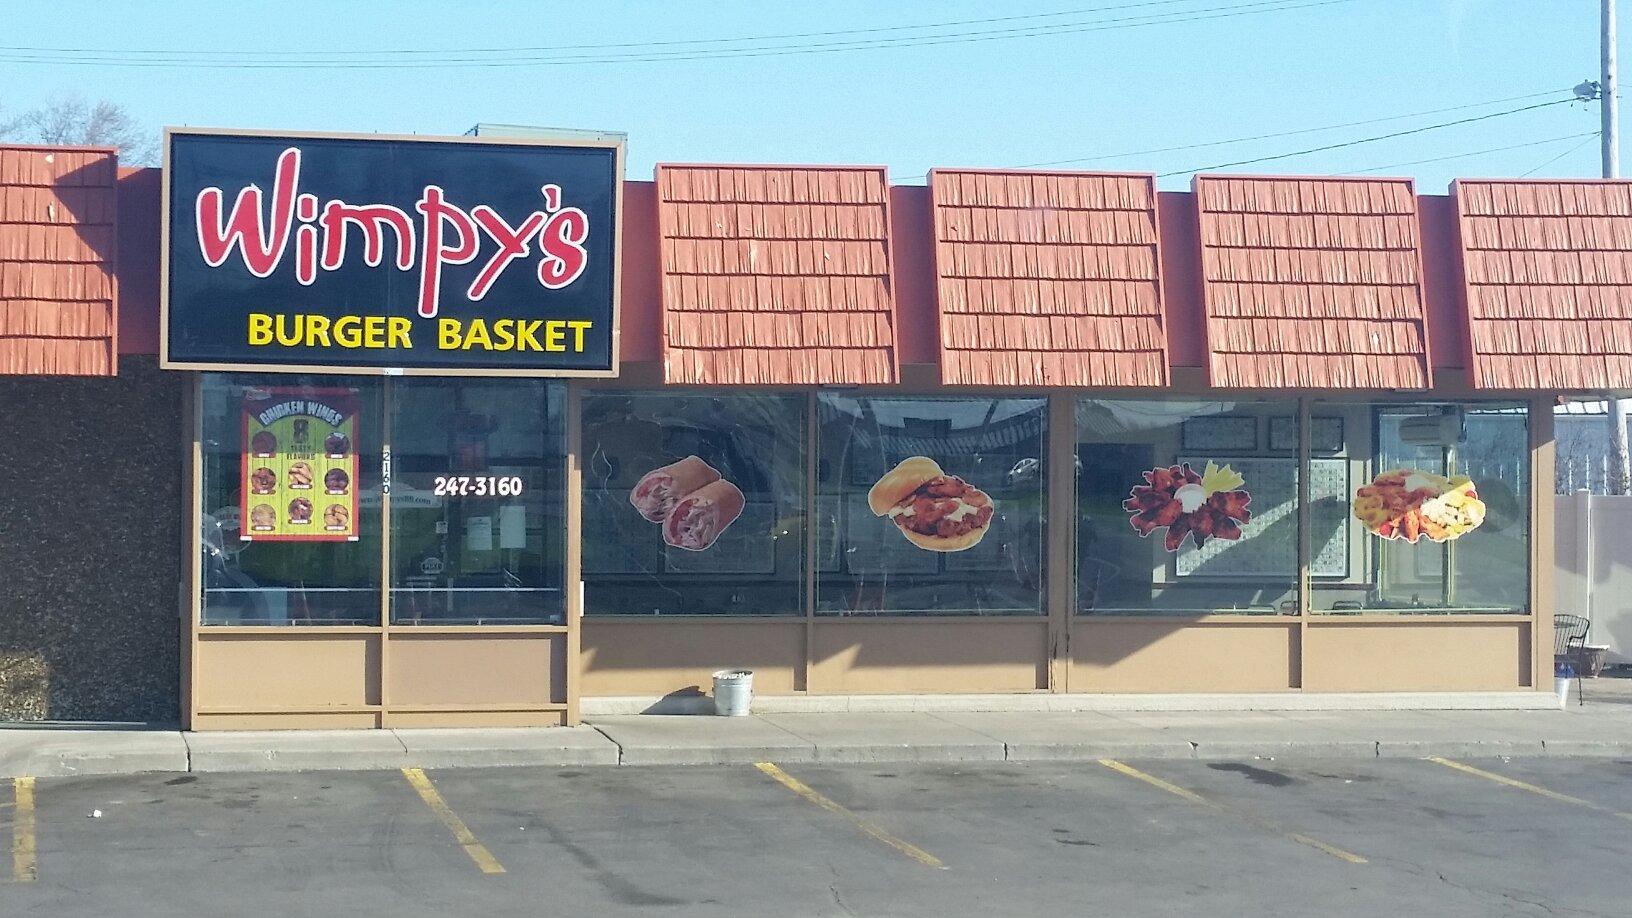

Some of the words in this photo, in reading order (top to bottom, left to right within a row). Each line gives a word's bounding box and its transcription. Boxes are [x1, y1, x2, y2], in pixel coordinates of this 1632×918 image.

[195, 146, 590, 319] Wimpy's
[248, 313, 413, 350] BURGER
[438, 318, 594, 354] BASKET
[259, 401, 305, 425] CHICKEN
[307, 401, 343, 426] WINGS
[293, 418, 309, 443] 8
[434, 476, 523, 496] 247-3160
